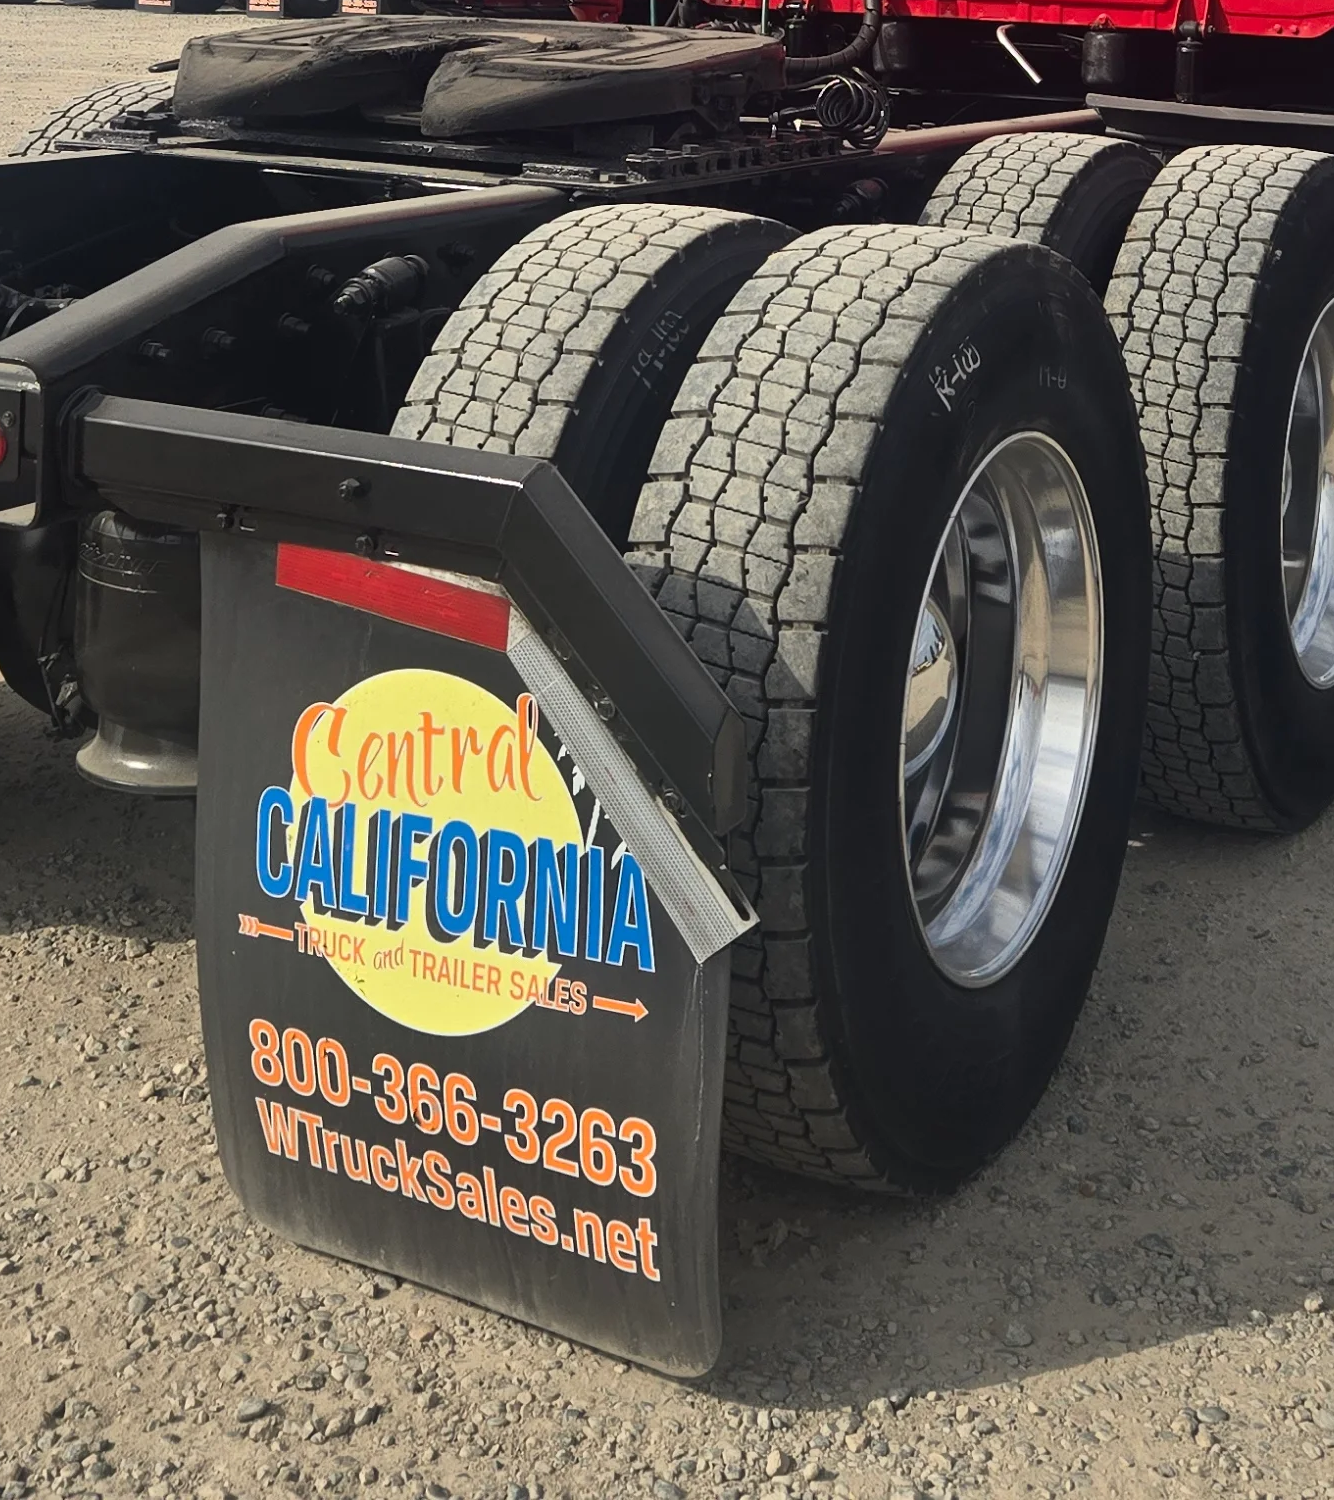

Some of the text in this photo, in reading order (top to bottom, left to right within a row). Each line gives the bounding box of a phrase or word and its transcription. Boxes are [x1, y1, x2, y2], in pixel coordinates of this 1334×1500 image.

[292, 692, 542, 808] Central
[255, 785, 656, 973] CALIFORNIA
[293, 921, 588, 1015] TRUCK and TRAILER SALES
[249, 1018, 657, 1198] 800-366-3263
[254, 1097, 661, 1282] WTruckSales.net
